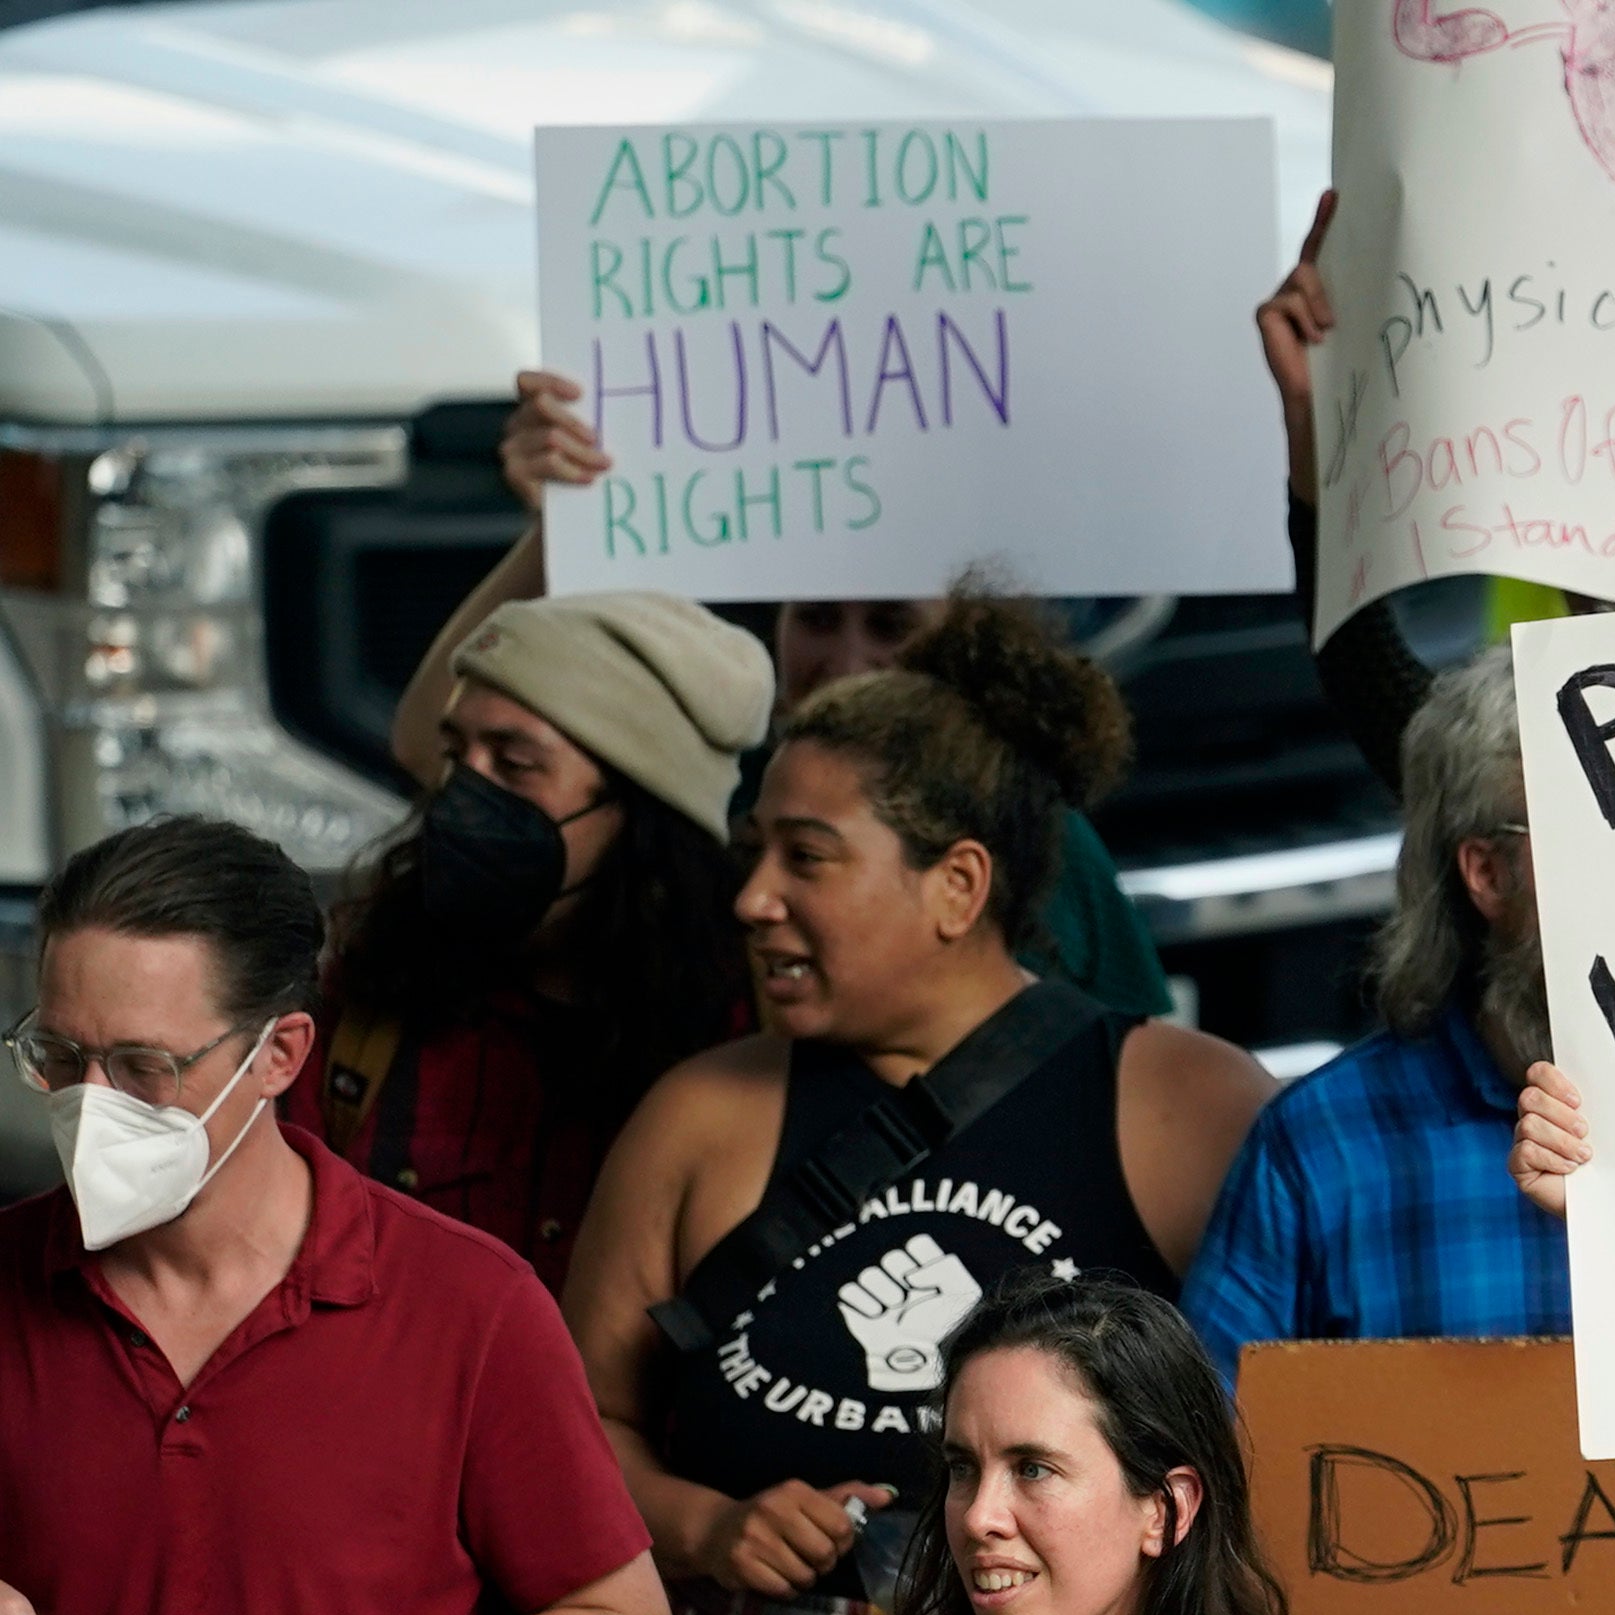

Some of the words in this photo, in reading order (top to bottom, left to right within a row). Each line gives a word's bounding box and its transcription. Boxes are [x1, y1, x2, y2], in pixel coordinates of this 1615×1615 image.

[589, 128, 991, 226] ABORTION
[589, 226, 852, 320] RIGHTS
[912, 215, 1034, 294] ARE
[592, 308, 1012, 453] HUMAN
[604, 455, 883, 558] RIGHTS
[859, 1177, 1063, 1256] ALLIANCE
[716, 1331, 773, 1400] THE
